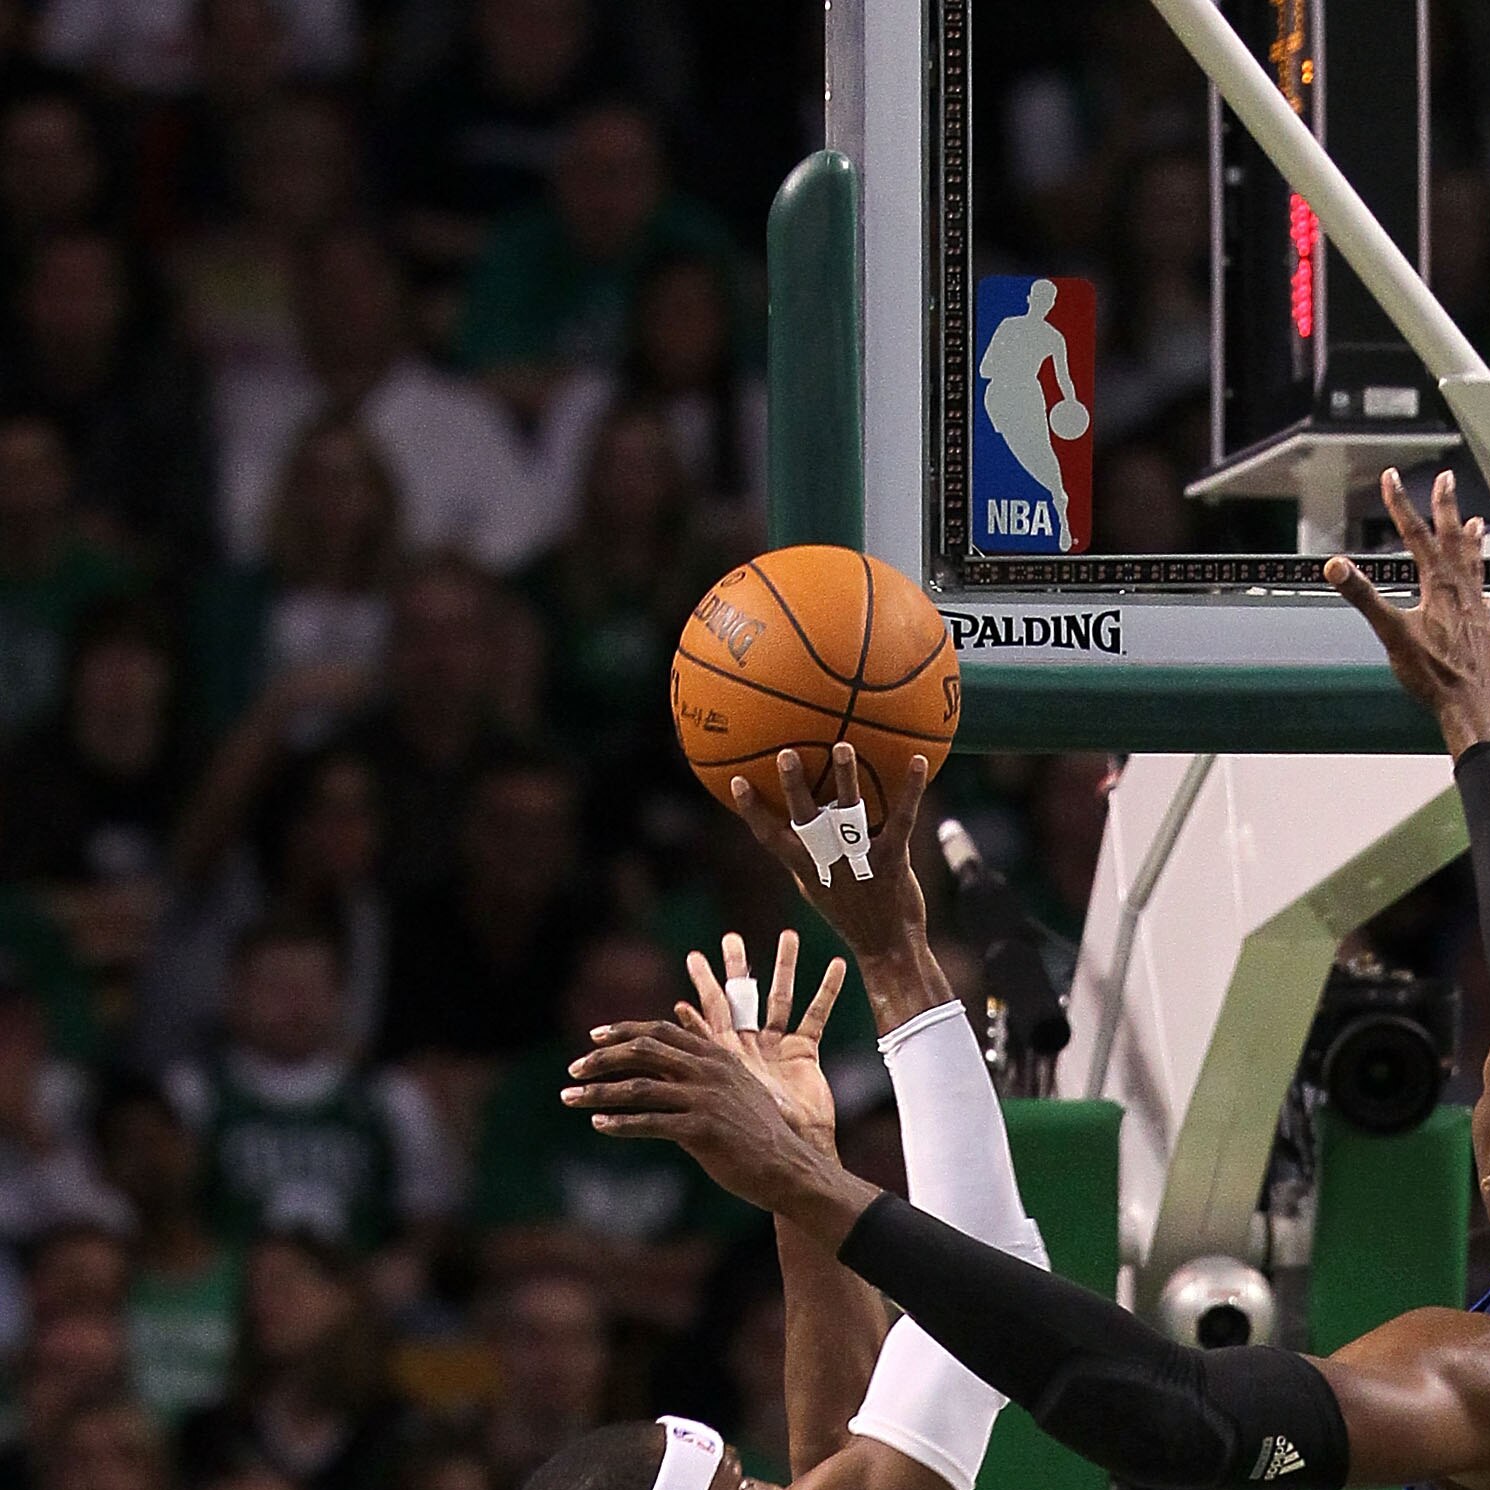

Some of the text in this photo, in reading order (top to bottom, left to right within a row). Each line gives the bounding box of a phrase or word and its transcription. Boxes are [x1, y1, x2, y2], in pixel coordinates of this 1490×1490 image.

[987, 498, 1053, 537] NBA
[938, 608, 1122, 655] PALDING
[839, 823, 861, 844] 6
